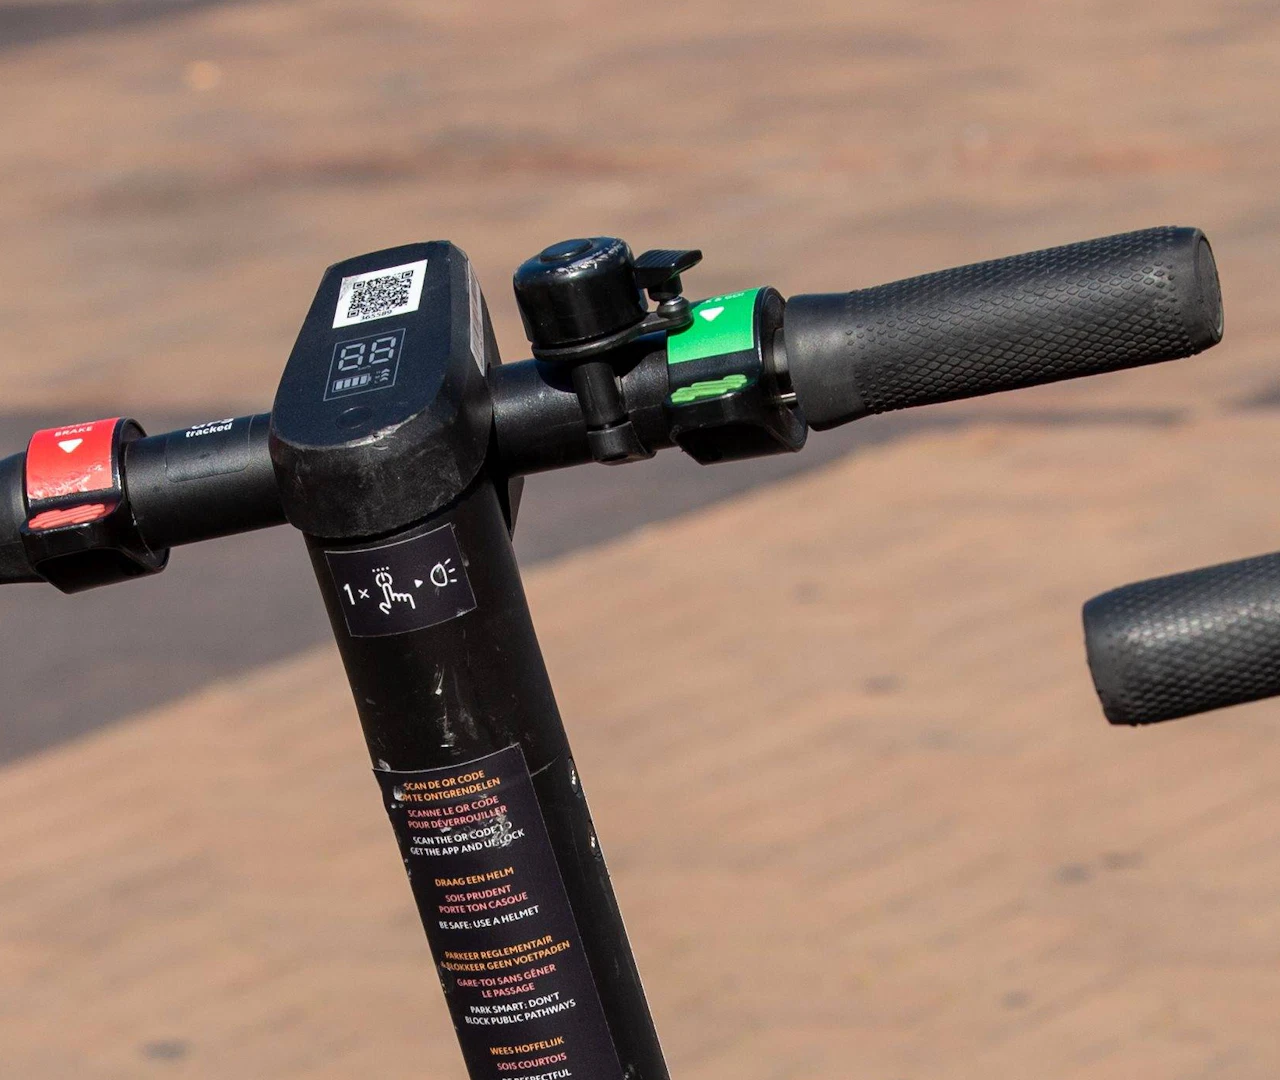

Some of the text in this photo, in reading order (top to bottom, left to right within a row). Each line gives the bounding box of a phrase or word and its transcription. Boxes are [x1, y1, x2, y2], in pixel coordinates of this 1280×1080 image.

[54, 426, 93, 437] BRAKE
[185, 422, 233, 437] tracked
[343, 583, 355, 605] 1
[414, 794, 422, 802] TE
[422, 777, 501, 801] ONTGRENDELEN
[429, 779, 440, 789] DE
[442, 776, 456, 787] QR
[458, 770, 485, 783] CODE
[408, 796, 499, 818] SCANNE LE QR CODE
[408, 805, 507, 829] POUR DÉVERROUILLER
[413, 836, 434, 845] SCAN
[434, 834, 453, 844] THE
[454, 831, 469, 842] QR
[470, 825, 497, 839] CODE
[410, 846, 424, 855] GET
[424, 845, 441, 856] THE
[442, 844, 459, 855] APP
[461, 840, 482, 853] AND
[435, 867, 514, 887] DRAAG EEN HELM
[439, 892, 528, 914] PORTE TON CASQUE
[445, 884, 512, 902] SOIS PRUDENT
[439, 905, 540, 929] BE SAFE: USE A HELMET
[445, 935, 553, 961] PARKEER REGLEMENTAIR
[486, 958, 512, 970] GEEN
[513, 940, 570, 965] VOETPADEN
[456, 963, 557, 988] GARE-TOI SANS GÊNER
[481, 982, 535, 998] LE PASSAGE
[465, 998, 576, 1025] BLOCK PUBLIC PATHWAYS
[470, 991, 560, 1014] PARK SMART: DON'T
[490, 1036, 565, 1055] WEES HOFFELIJK
[497, 1052, 567, 1071] SOIS COURTOIS
